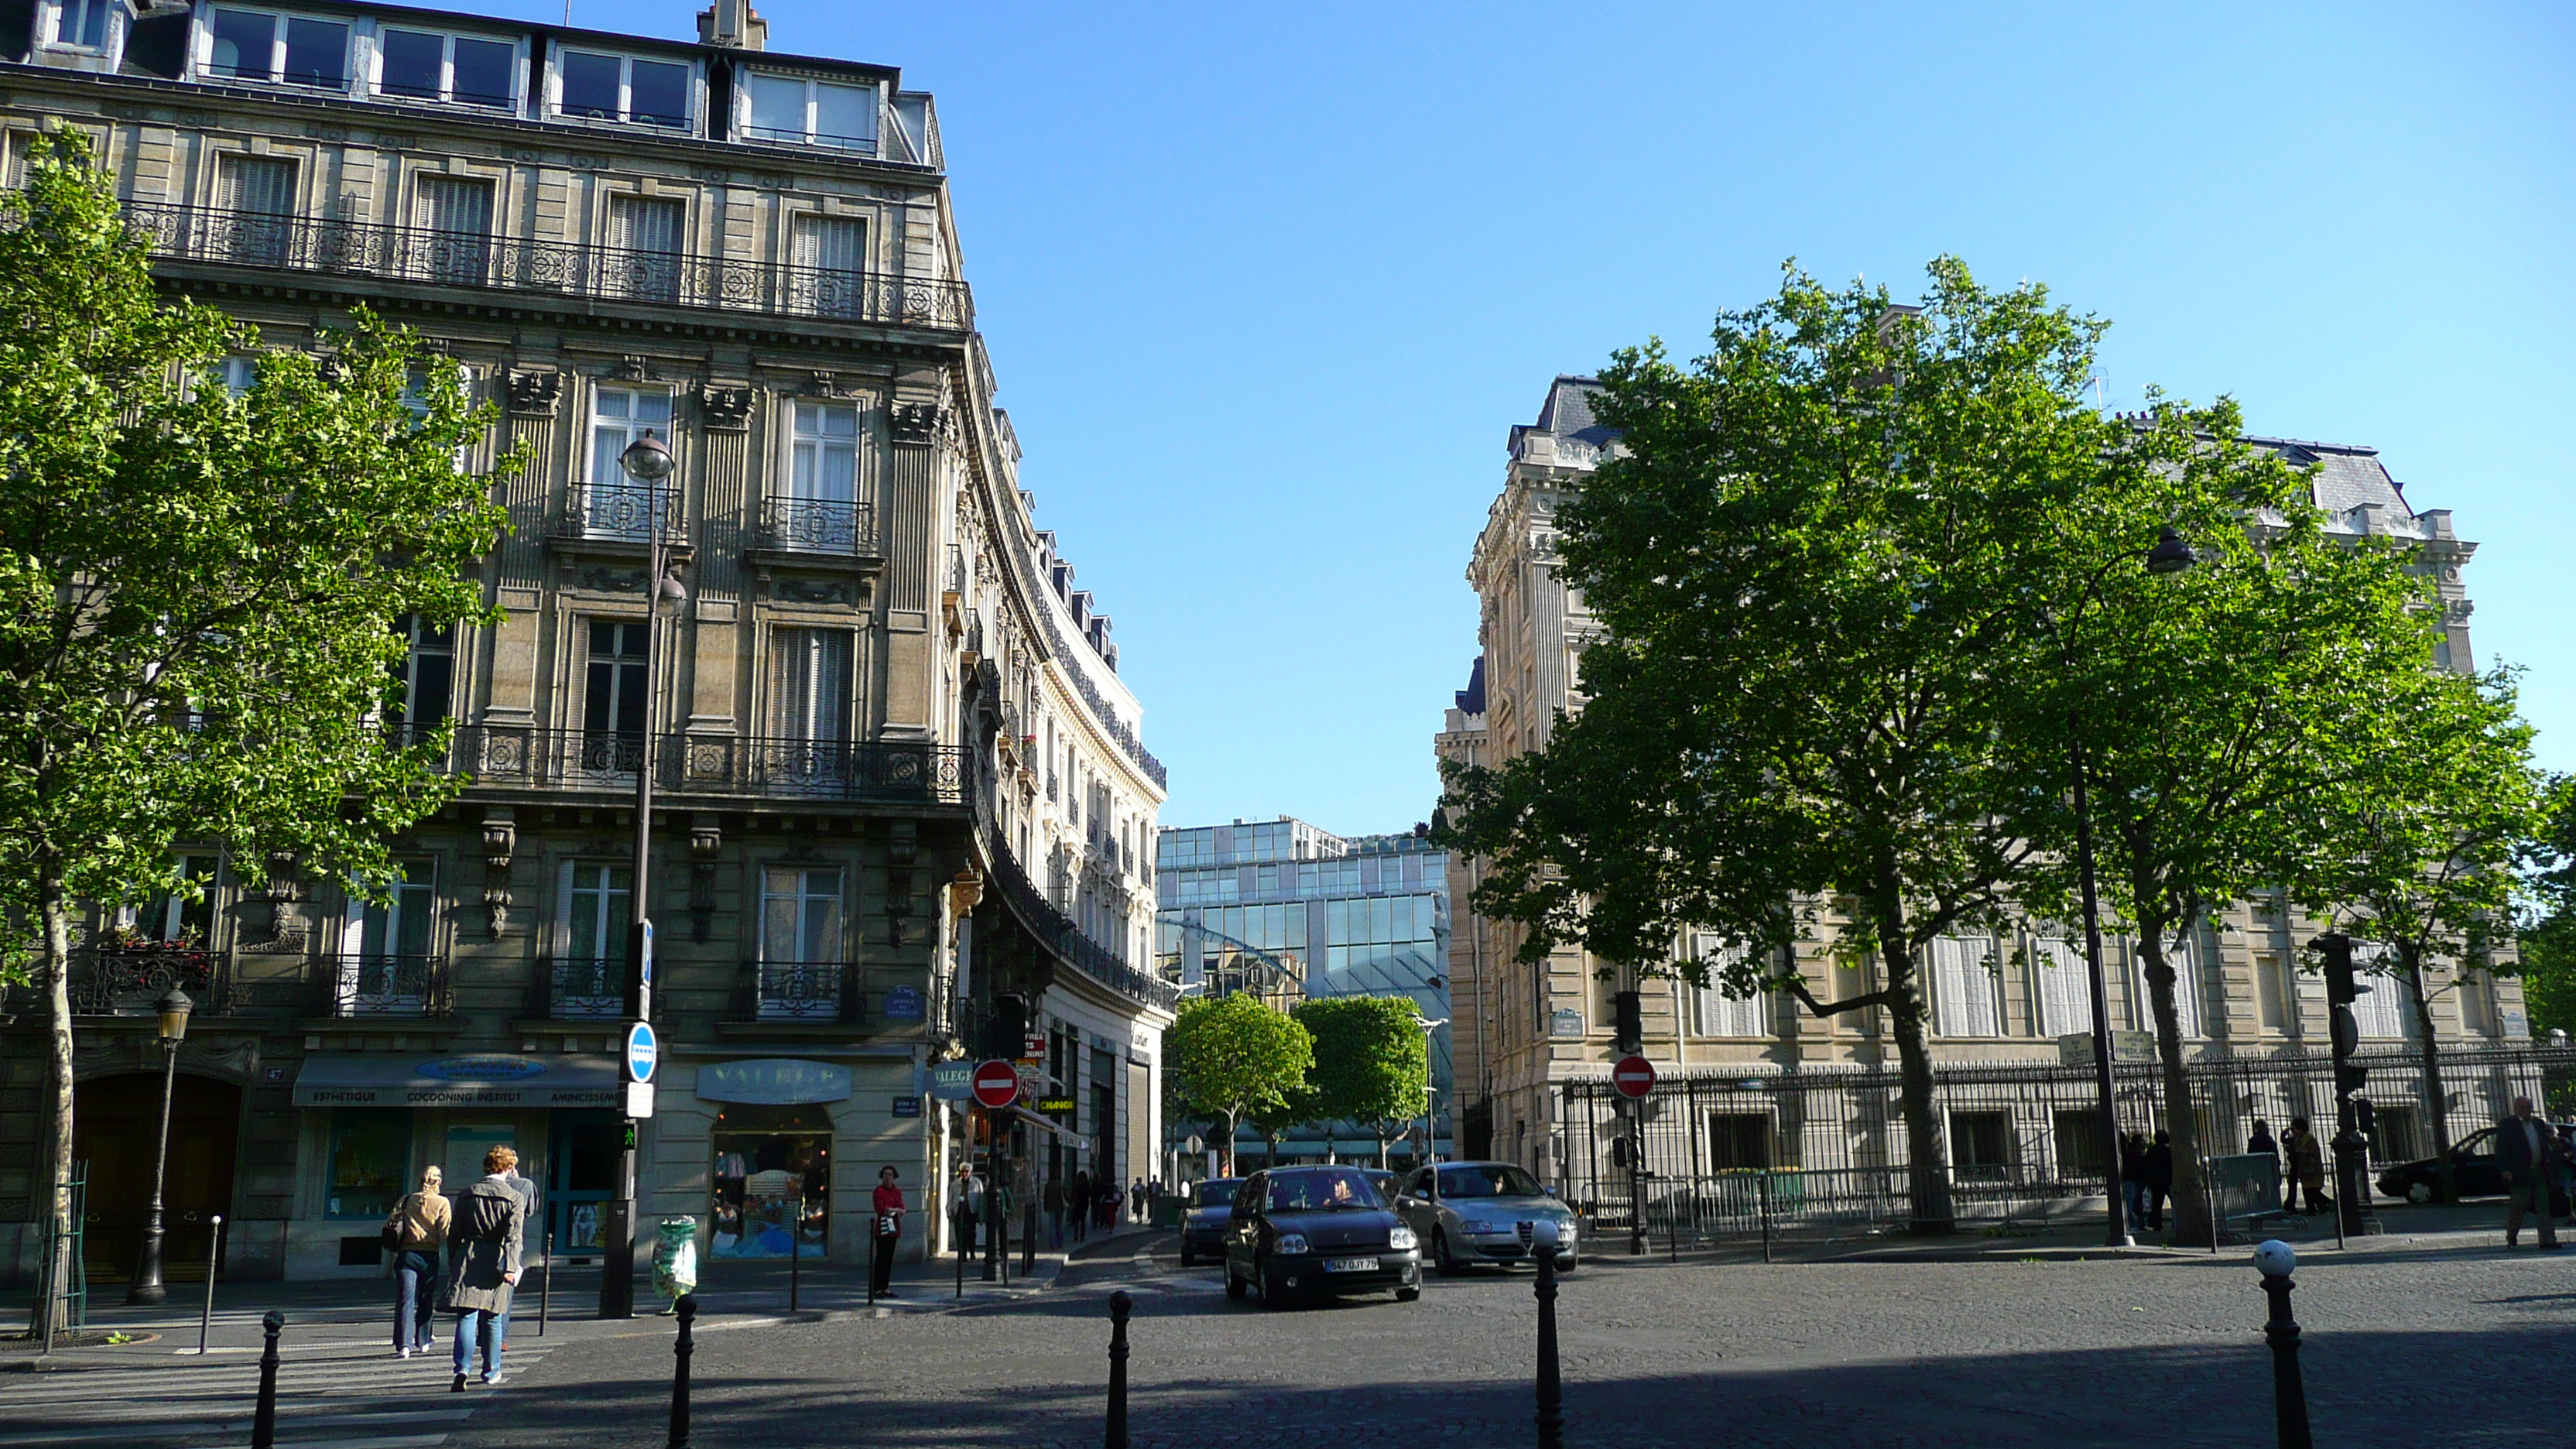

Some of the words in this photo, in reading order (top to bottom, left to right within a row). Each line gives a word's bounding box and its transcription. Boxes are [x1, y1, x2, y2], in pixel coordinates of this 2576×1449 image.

[268, 1069, 283, 1080] 47
[313, 1091, 376, 1102] ESTHETIQUE
[407, 1092, 473, 1102] COCOONING
[477, 1092, 522, 1102] INSTITUT
[1040, 1100, 1074, 1110] CHANGE
